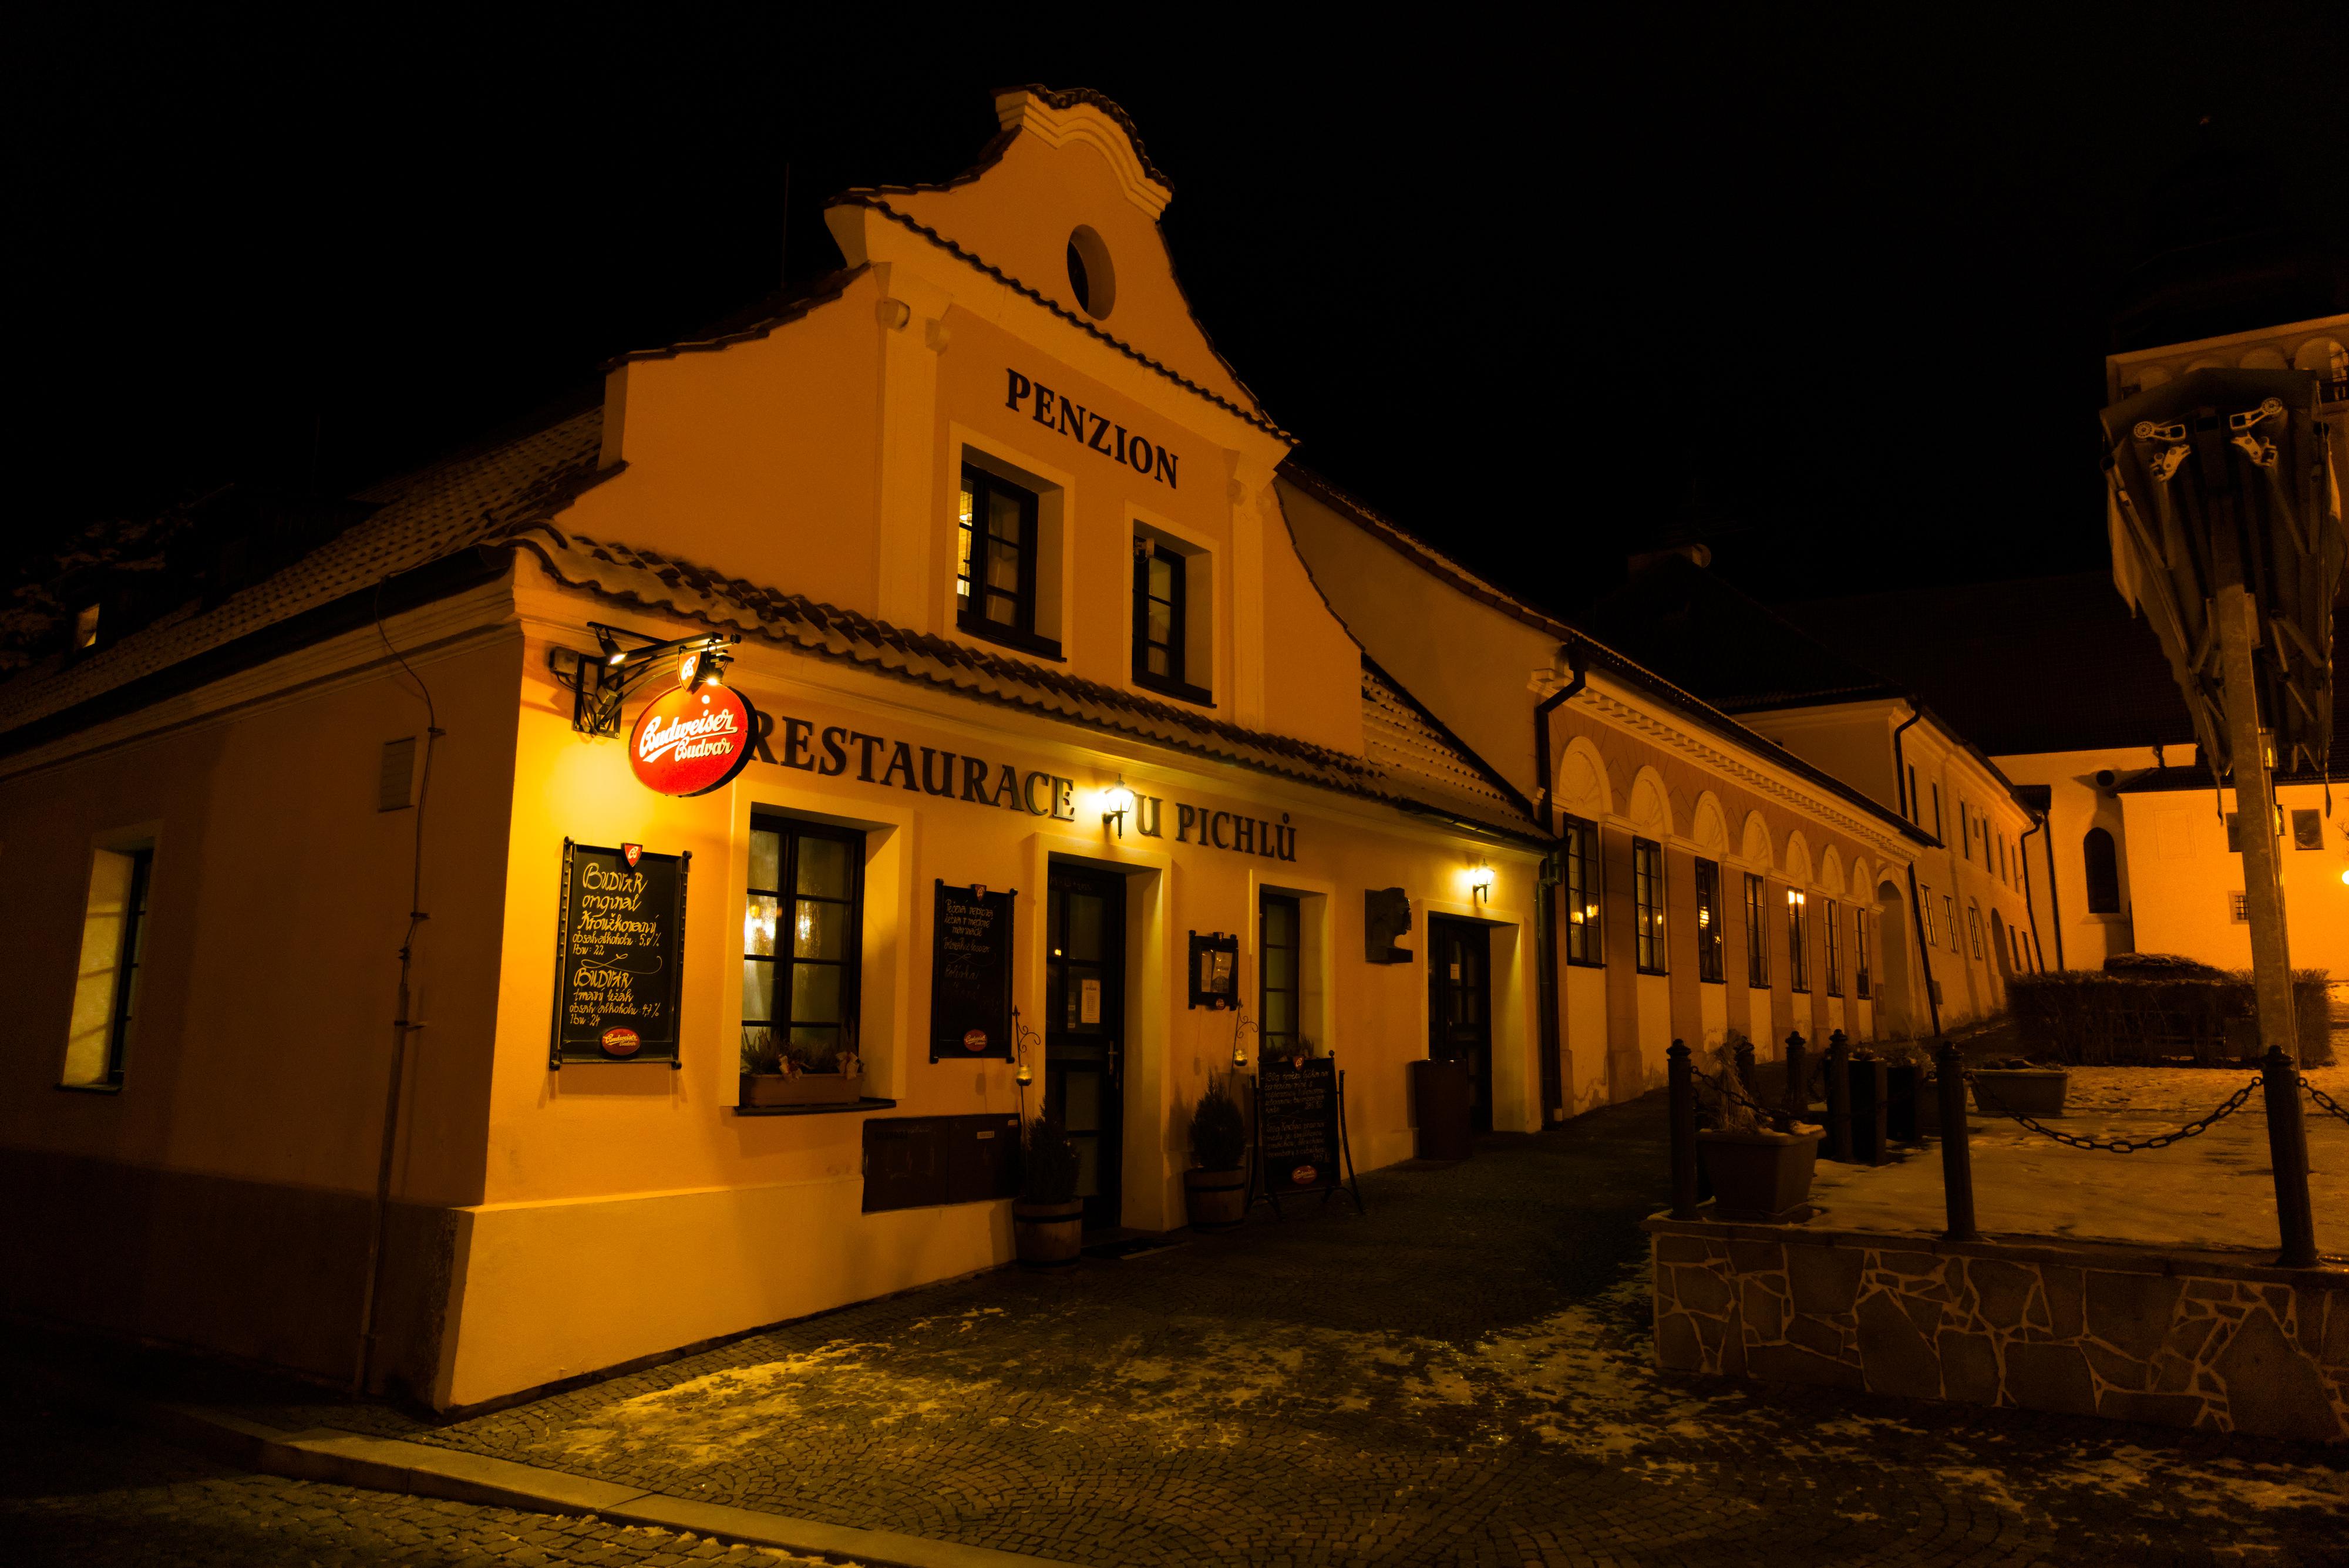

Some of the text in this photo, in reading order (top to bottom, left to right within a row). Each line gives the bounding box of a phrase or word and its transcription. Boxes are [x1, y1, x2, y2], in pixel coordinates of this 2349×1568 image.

[1005, 368, 1179, 489] PENZION
[639, 709, 738, 758] Budweiser
[675, 737, 734, 762] Budvar
[749, 710, 1296, 862] RESTAURACE U PICHLŮ
[582, 892, 642, 917] original
